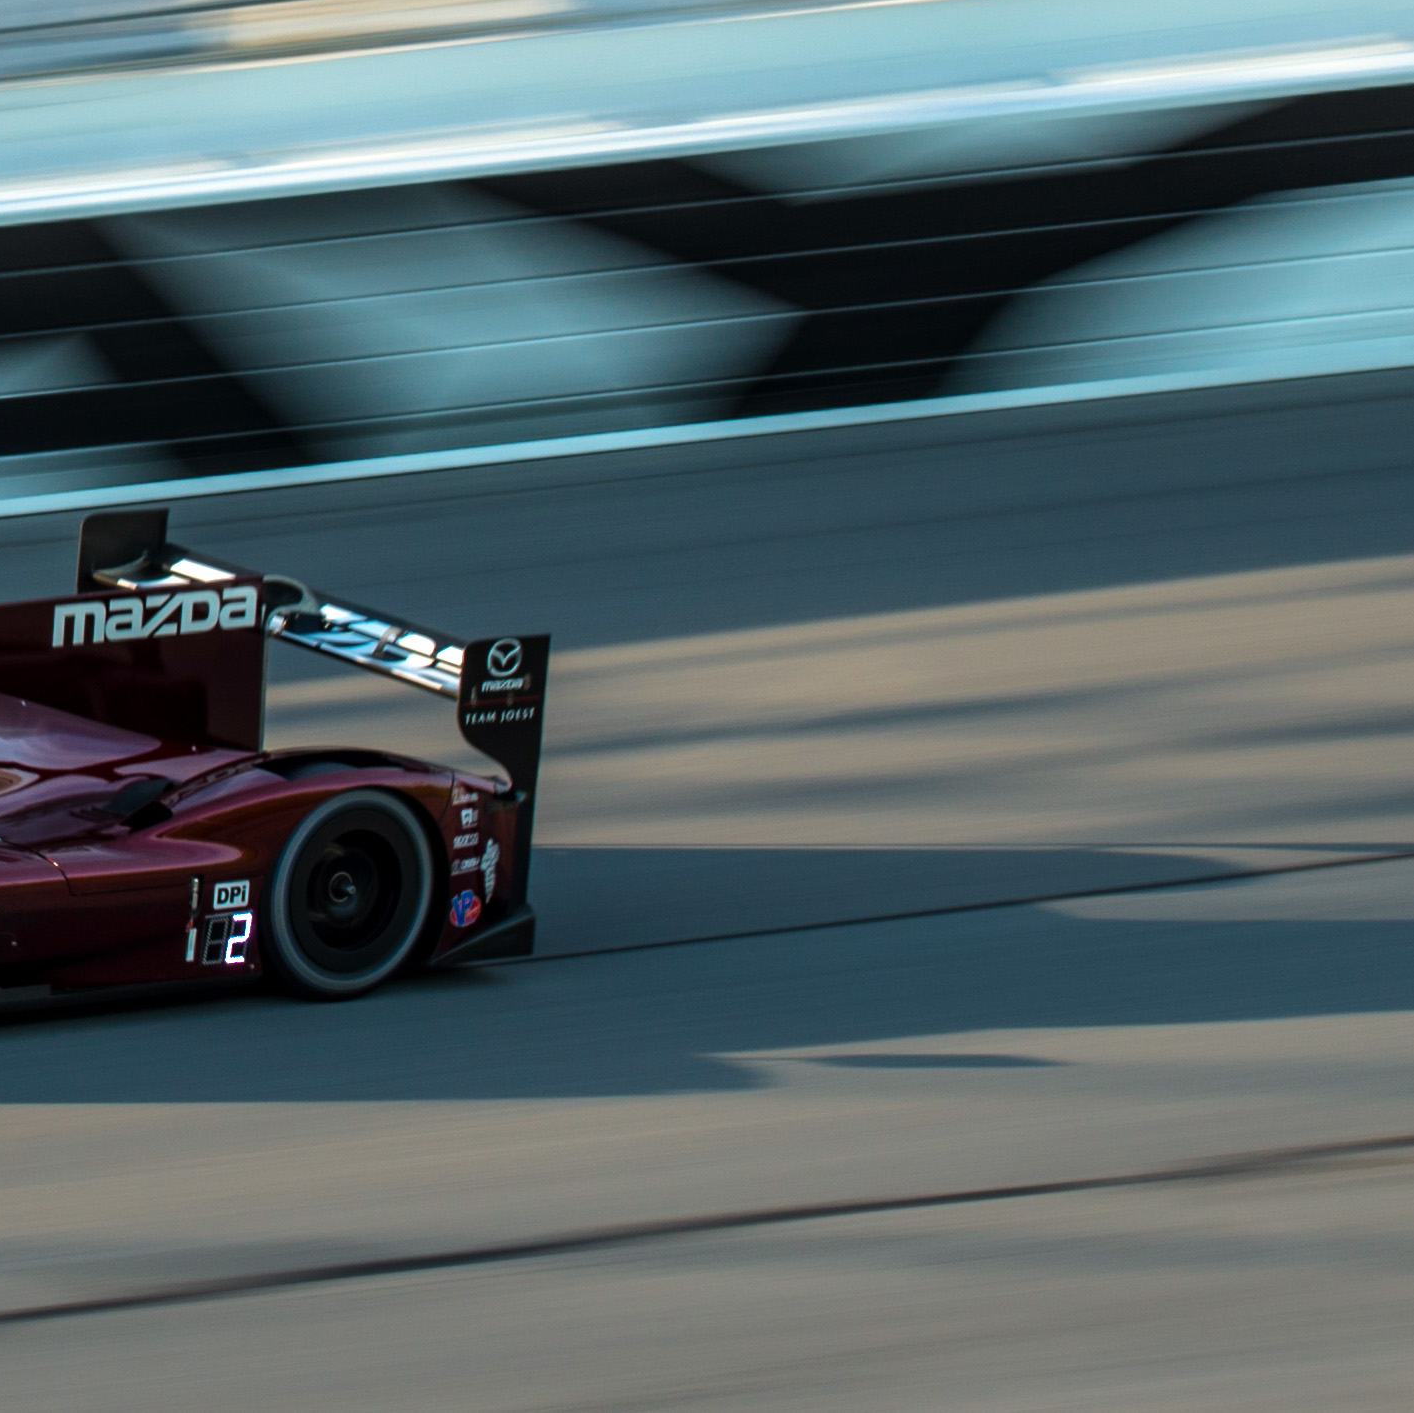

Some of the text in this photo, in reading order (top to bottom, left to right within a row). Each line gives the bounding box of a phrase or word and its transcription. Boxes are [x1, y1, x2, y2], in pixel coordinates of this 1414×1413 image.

[465, 707, 535, 726] TEAM JOEST
[217, 885, 247, 905] DPi
[224, 911, 253, 964] 2
